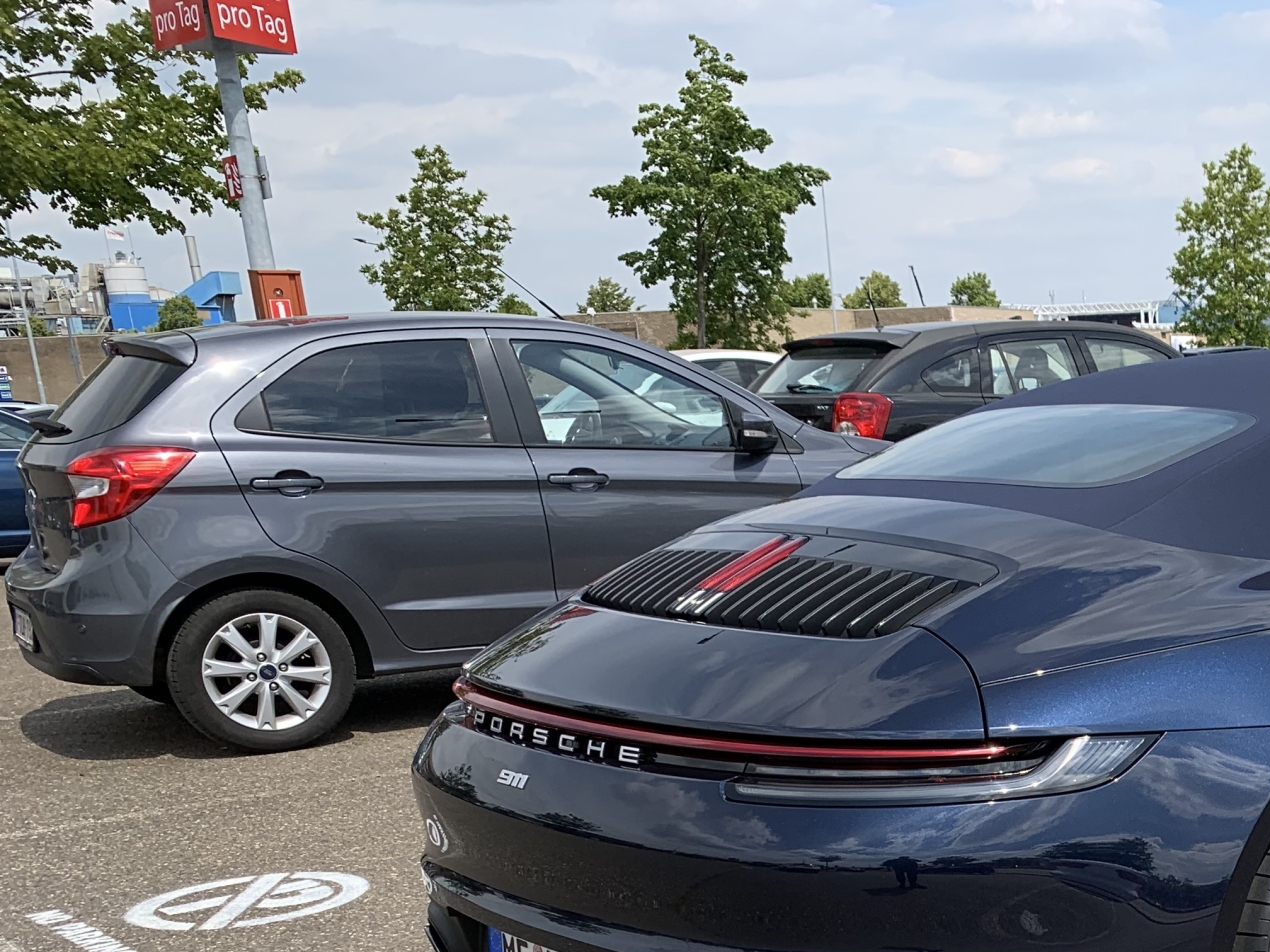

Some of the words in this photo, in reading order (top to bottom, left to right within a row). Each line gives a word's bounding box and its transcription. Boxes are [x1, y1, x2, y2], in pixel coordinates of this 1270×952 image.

[155, 10, 176, 41] pro
[175, 1, 200, 32] Tag
[217, 2, 251, 29] pro
[251, 4, 288, 44] Tag
[473, 710, 641, 765] PORSCHE
[496, 768, 530, 790] 911
